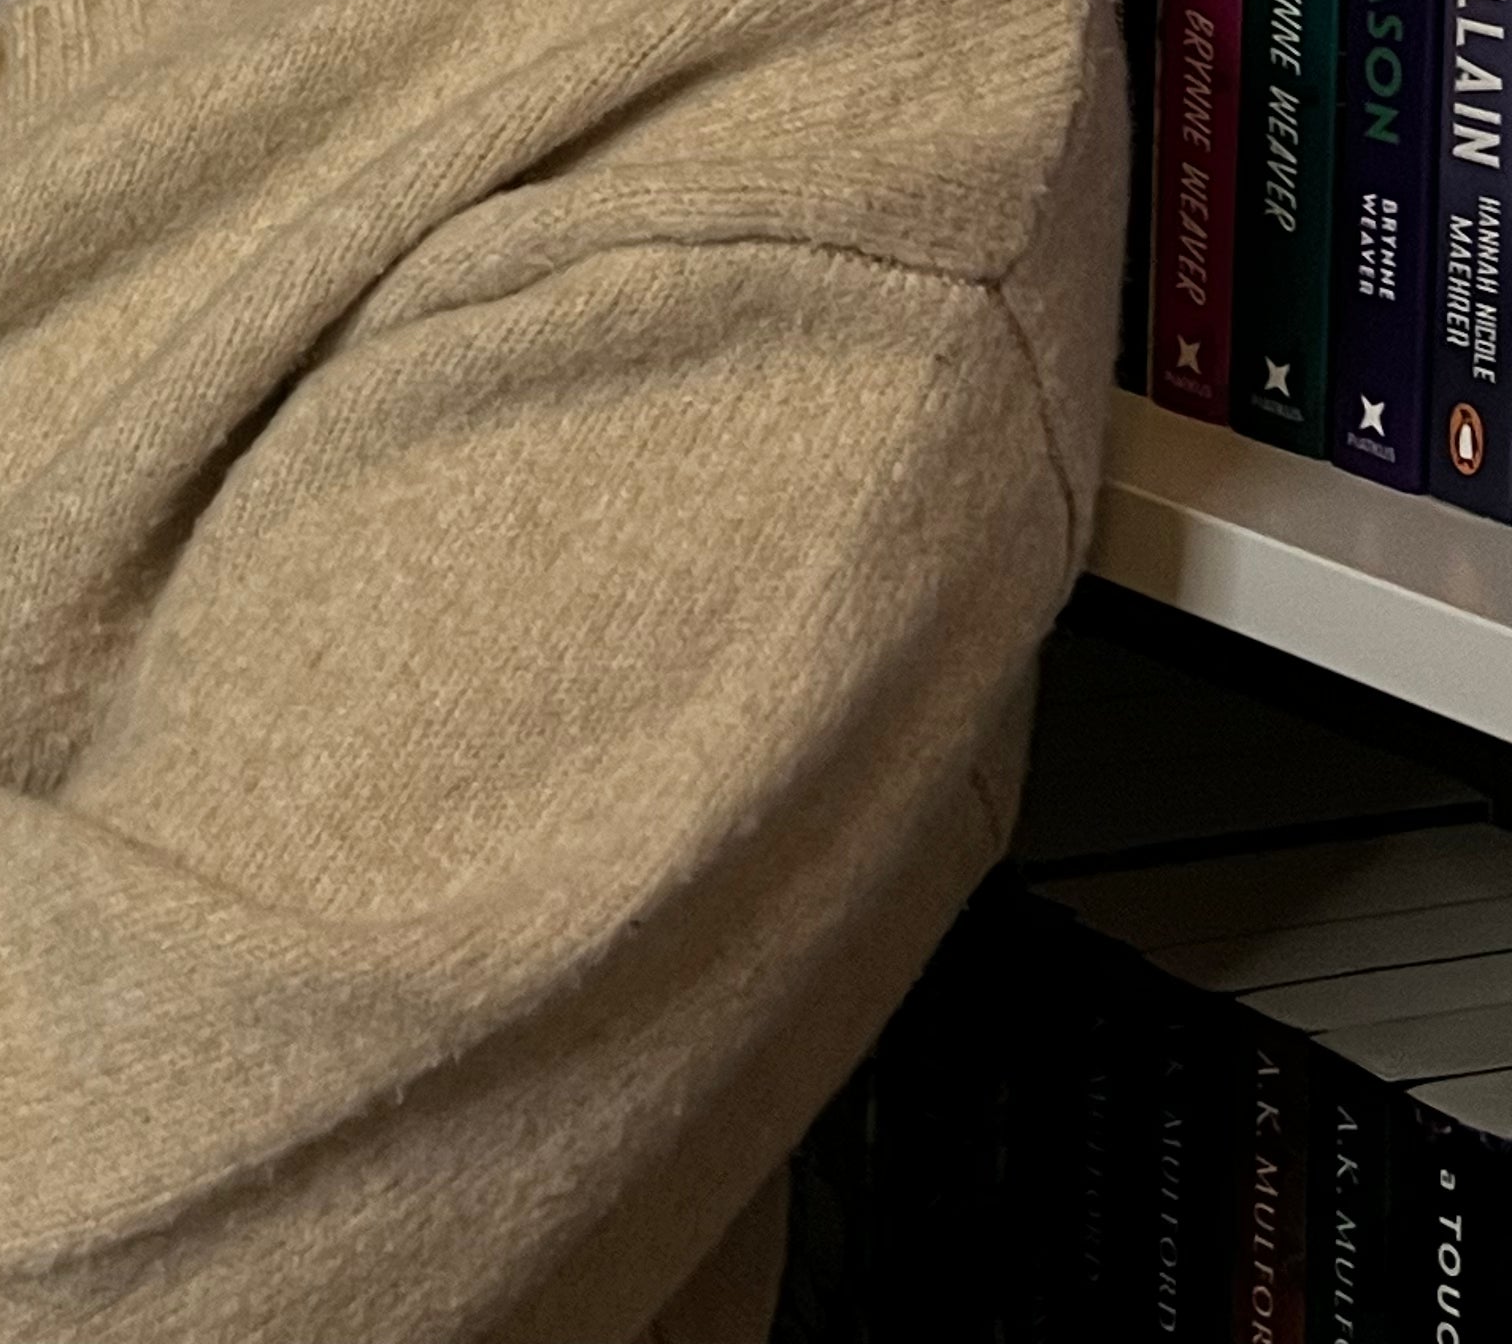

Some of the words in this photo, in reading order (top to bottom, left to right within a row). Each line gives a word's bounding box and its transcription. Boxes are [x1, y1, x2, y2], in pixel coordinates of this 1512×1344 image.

[1181, 7, 1217, 155] BRYNNE
[1263, 84, 1304, 235] WEAVER
[1173, 158, 1213, 308] WEAVER
[1357, 192, 1379, 297] WEAVER
[1378, 197, 1400, 303] BRYNNE
[1445, 213, 1475, 349] MAEHRER
[1476, 195, 1503, 304] HANNAH
[1472, 305, 1501, 385] NICOLE
[1249, 1151, 1279, 1344] MULFOR
